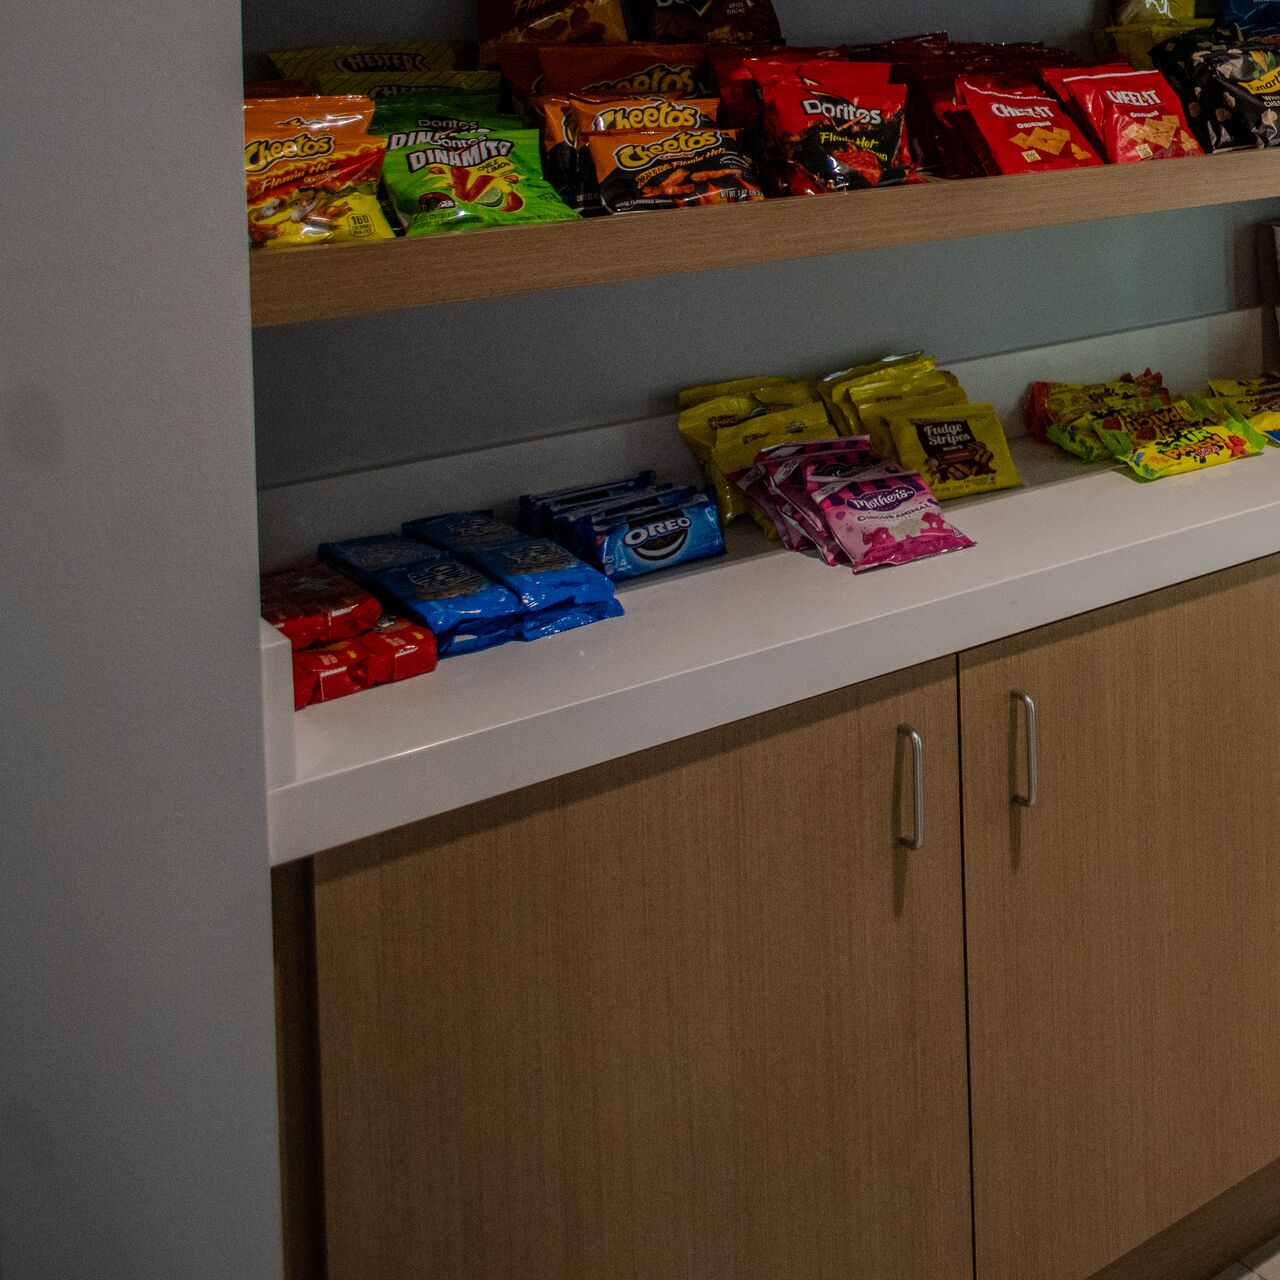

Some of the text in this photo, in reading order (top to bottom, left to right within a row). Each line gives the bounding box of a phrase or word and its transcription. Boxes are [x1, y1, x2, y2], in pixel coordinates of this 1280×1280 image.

[801, 99, 881, 125] Doritos
[417, 118, 480, 130] Doritos
[615, 130, 721, 170] Cheetos
[856, 136, 880, 149] Hot
[244, 132, 334, 173] Cheetos
[310, 161, 337, 175] Hot
[924, 422, 963, 436] Fudge
[927, 433, 971, 446] Stripes
[851, 487, 912, 509] Mother's
[623, 516, 692, 547] OREO
